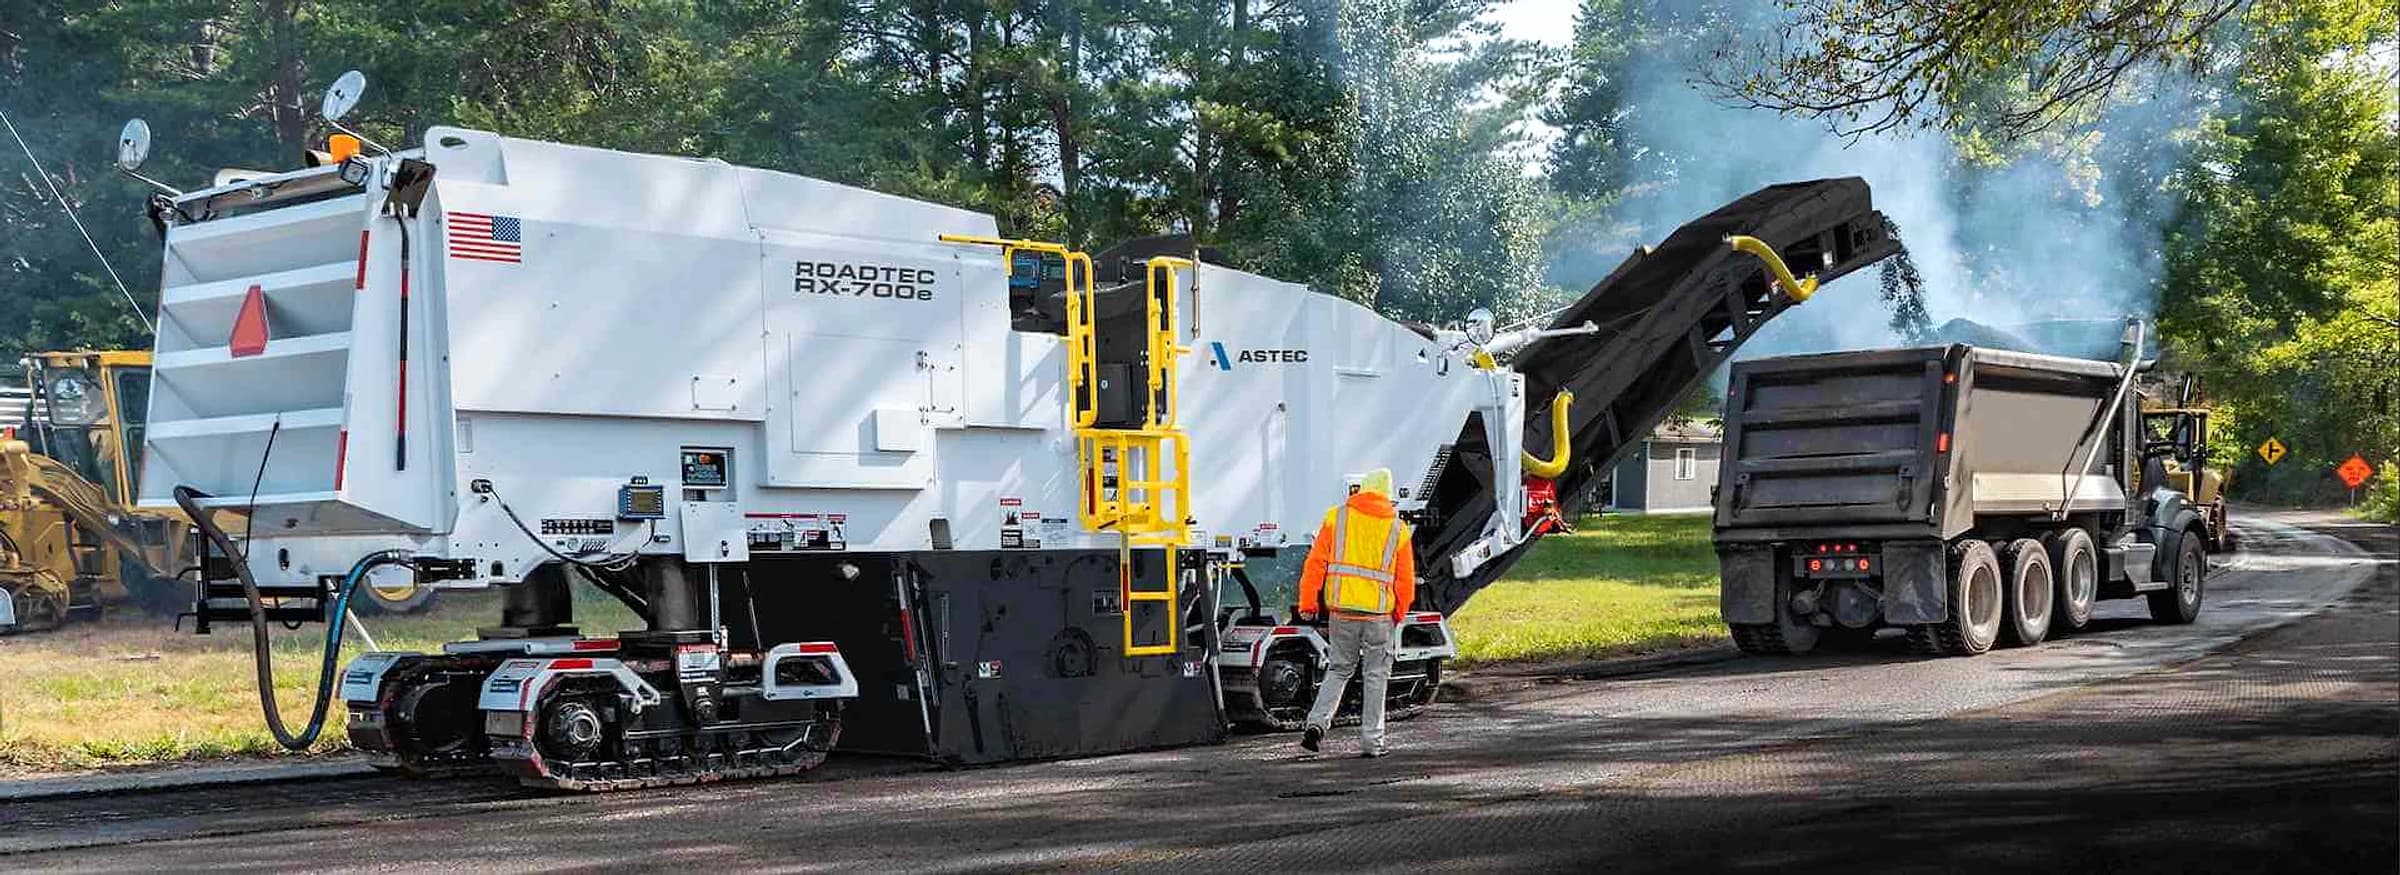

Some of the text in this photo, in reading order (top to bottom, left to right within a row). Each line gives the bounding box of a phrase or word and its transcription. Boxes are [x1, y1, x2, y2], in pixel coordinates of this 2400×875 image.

[795, 261, 935, 284] ROADTEC
[794, 277, 933, 301] RX-700e
[1238, 350, 1308, 362] ASTEC
